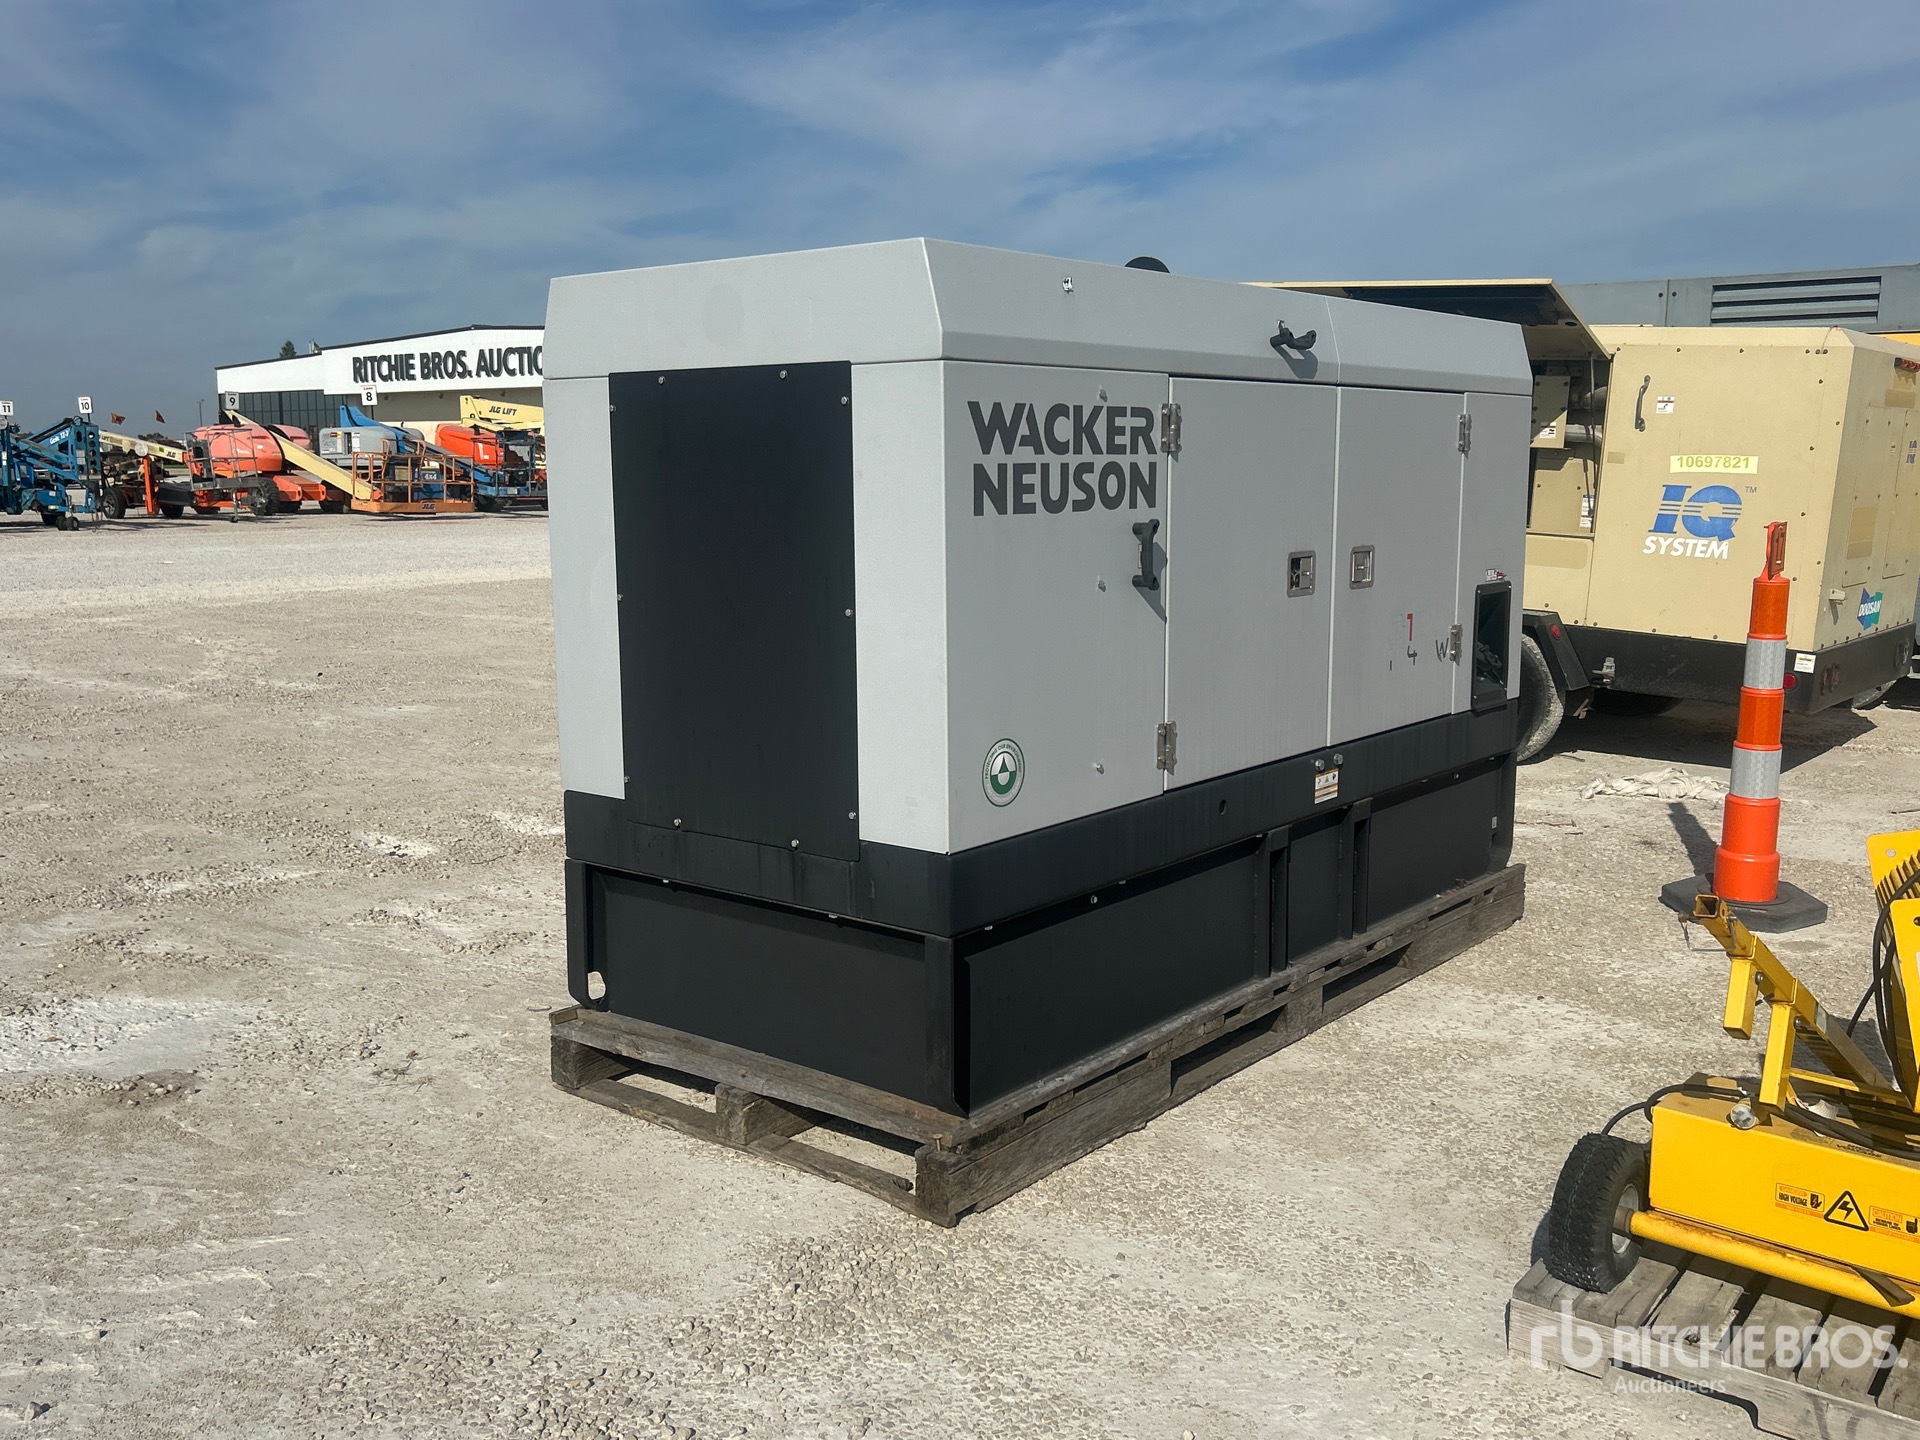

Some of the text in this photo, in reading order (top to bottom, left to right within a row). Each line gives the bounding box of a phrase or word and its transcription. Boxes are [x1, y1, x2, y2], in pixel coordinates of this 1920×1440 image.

[353, 353, 416, 383] RITCHIE
[420, 350, 473, 380] BROS.
[229, 397, 236, 406] 9
[366, 392, 373, 401] 8
[81, 402, 90, 410] 10
[489, 405, 517, 416] JLG LIFT
[967, 401, 1158, 455] WACKER
[1677, 456, 1750, 469] 10697821
[973, 461, 1157, 516] NEUSON
[421, 502, 436, 510] JLG
[1648, 485, 1743, 541] IQ
[1642, 536, 1729, 559] SYSTEM
[1858, 600, 1882, 616] DOOSAN
[1778, 1192, 1808, 1206] HIGH VOLTAGE
[1873, 1208, 1902, 1223] CAUTION
